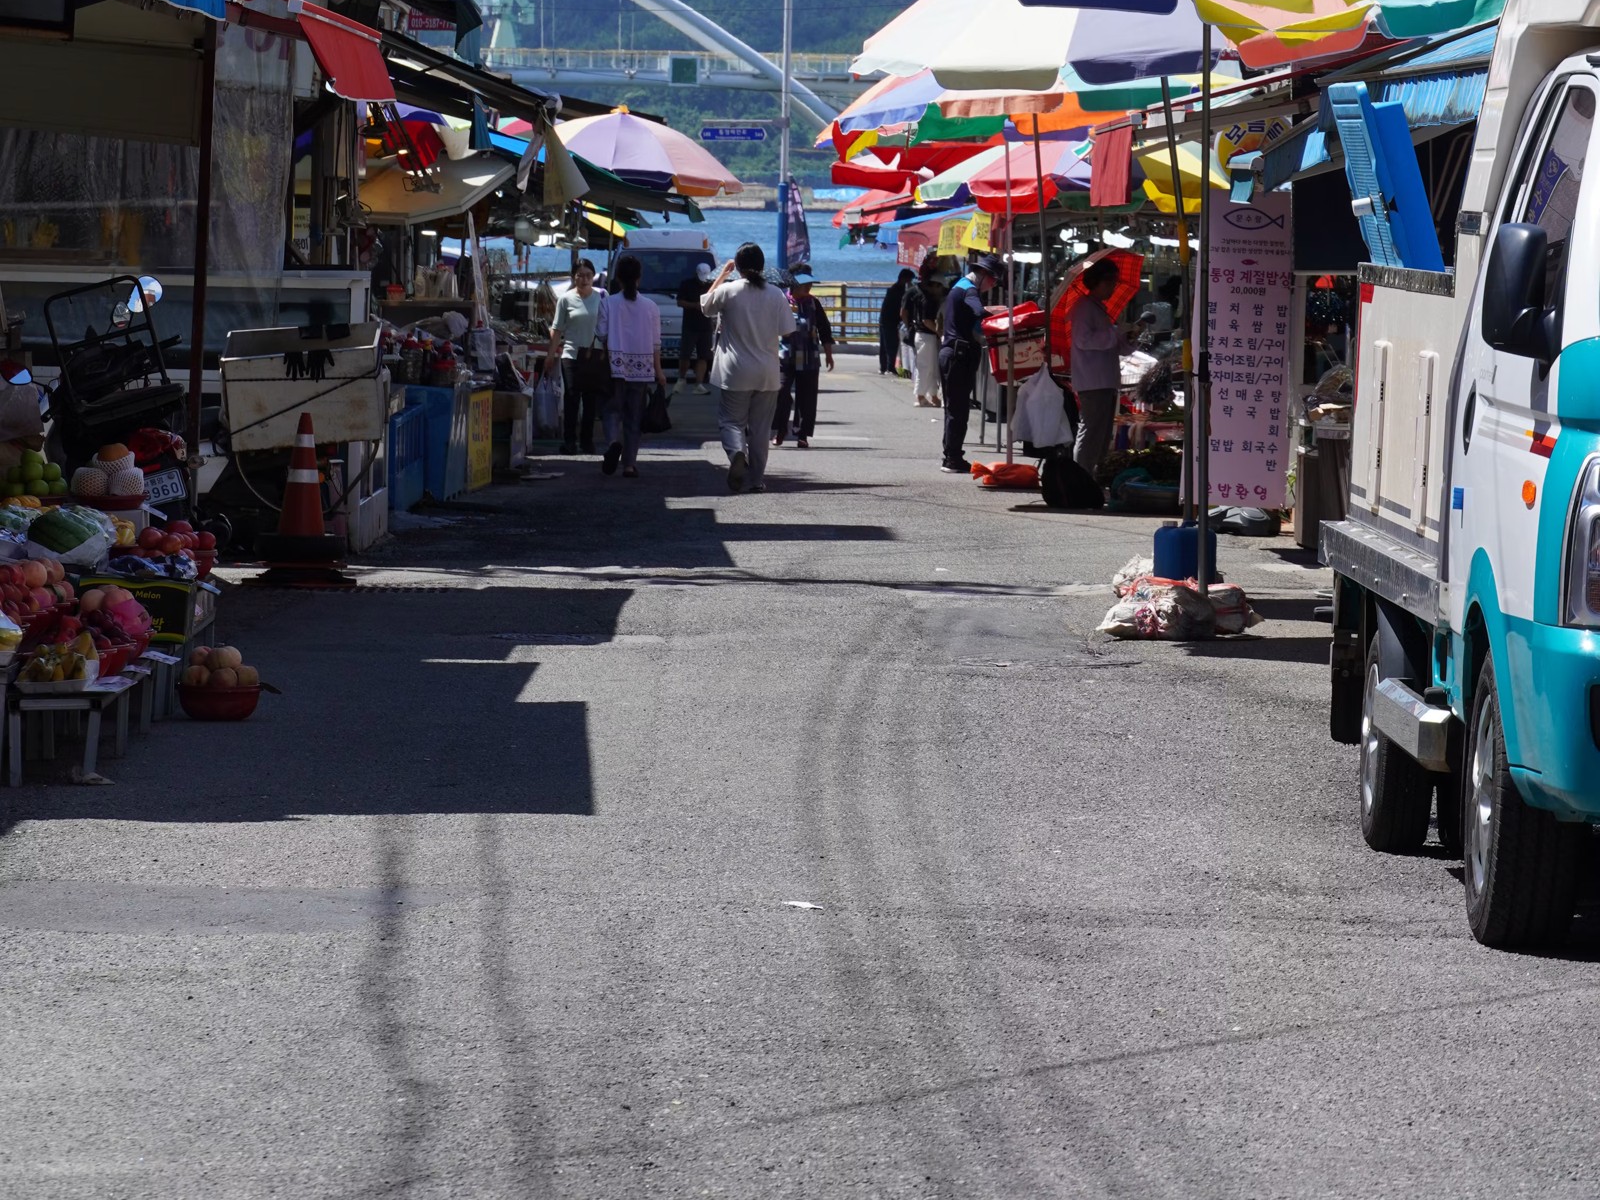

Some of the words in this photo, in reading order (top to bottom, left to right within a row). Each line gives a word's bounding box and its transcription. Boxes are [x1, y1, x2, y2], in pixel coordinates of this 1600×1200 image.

[1210, 268, 1235, 284] 통영
[1210, 371, 1283, 385] 자미조림/구이
[135, 590, 161, 599] Melon
